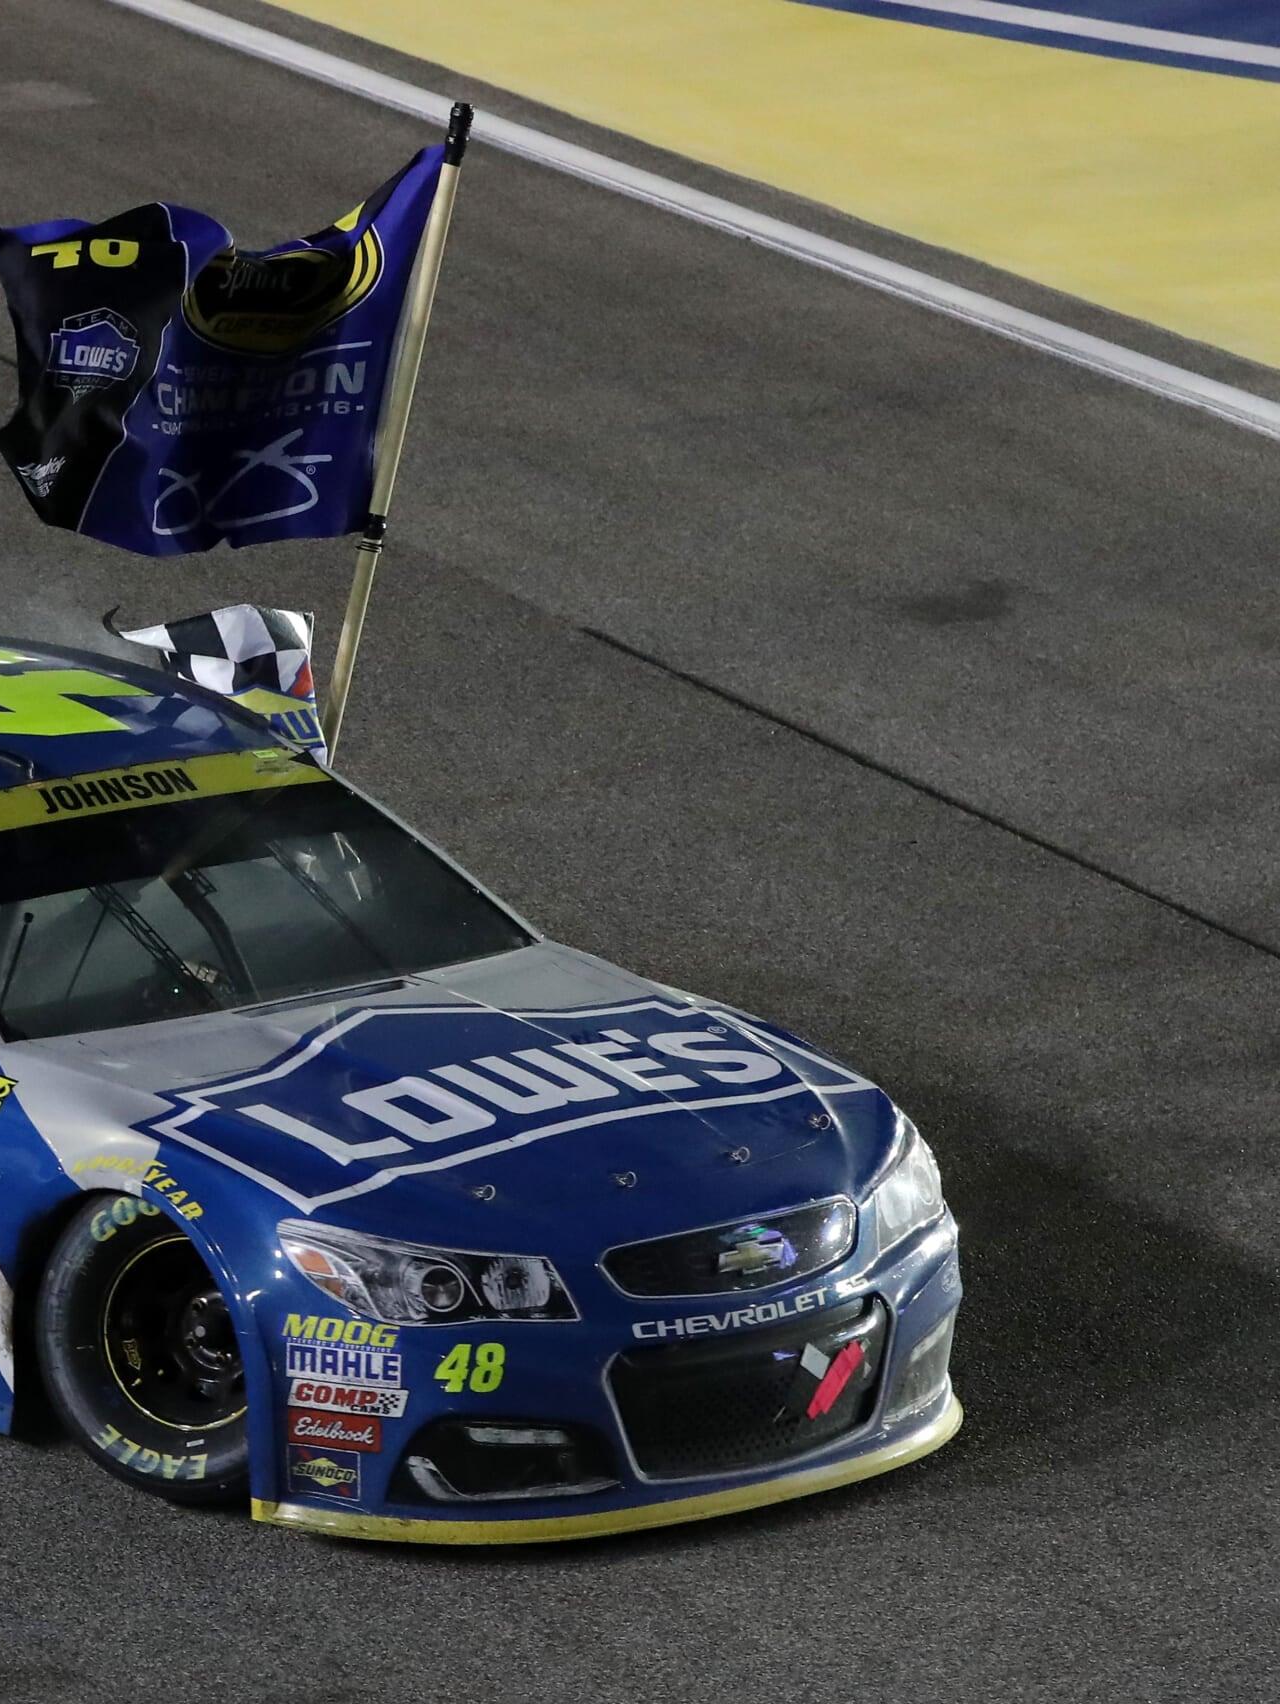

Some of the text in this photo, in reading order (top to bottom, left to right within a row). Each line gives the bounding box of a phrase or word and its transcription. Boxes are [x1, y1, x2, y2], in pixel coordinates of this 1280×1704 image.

[77, 311, 131, 332] TEAM
[58, 339, 127, 374] LOWE'S
[38, 768, 199, 815] JOHNSON
[236, 1028, 783, 1166] LOWE'S
[632, 1275, 870, 1339] CHEVROLET SS
[282, 1313, 401, 1348] MOOG
[289, 1347, 400, 1382] MAHLE
[433, 1343, 506, 1393] 48
[295, 1382, 379, 1408] COMP
[350, 1403, 391, 1416] CAMS
[294, 1416, 375, 1445] Edelbrock
[91, 1423, 208, 1481] EAGLE
[295, 1462, 357, 1483] SUNOCO
